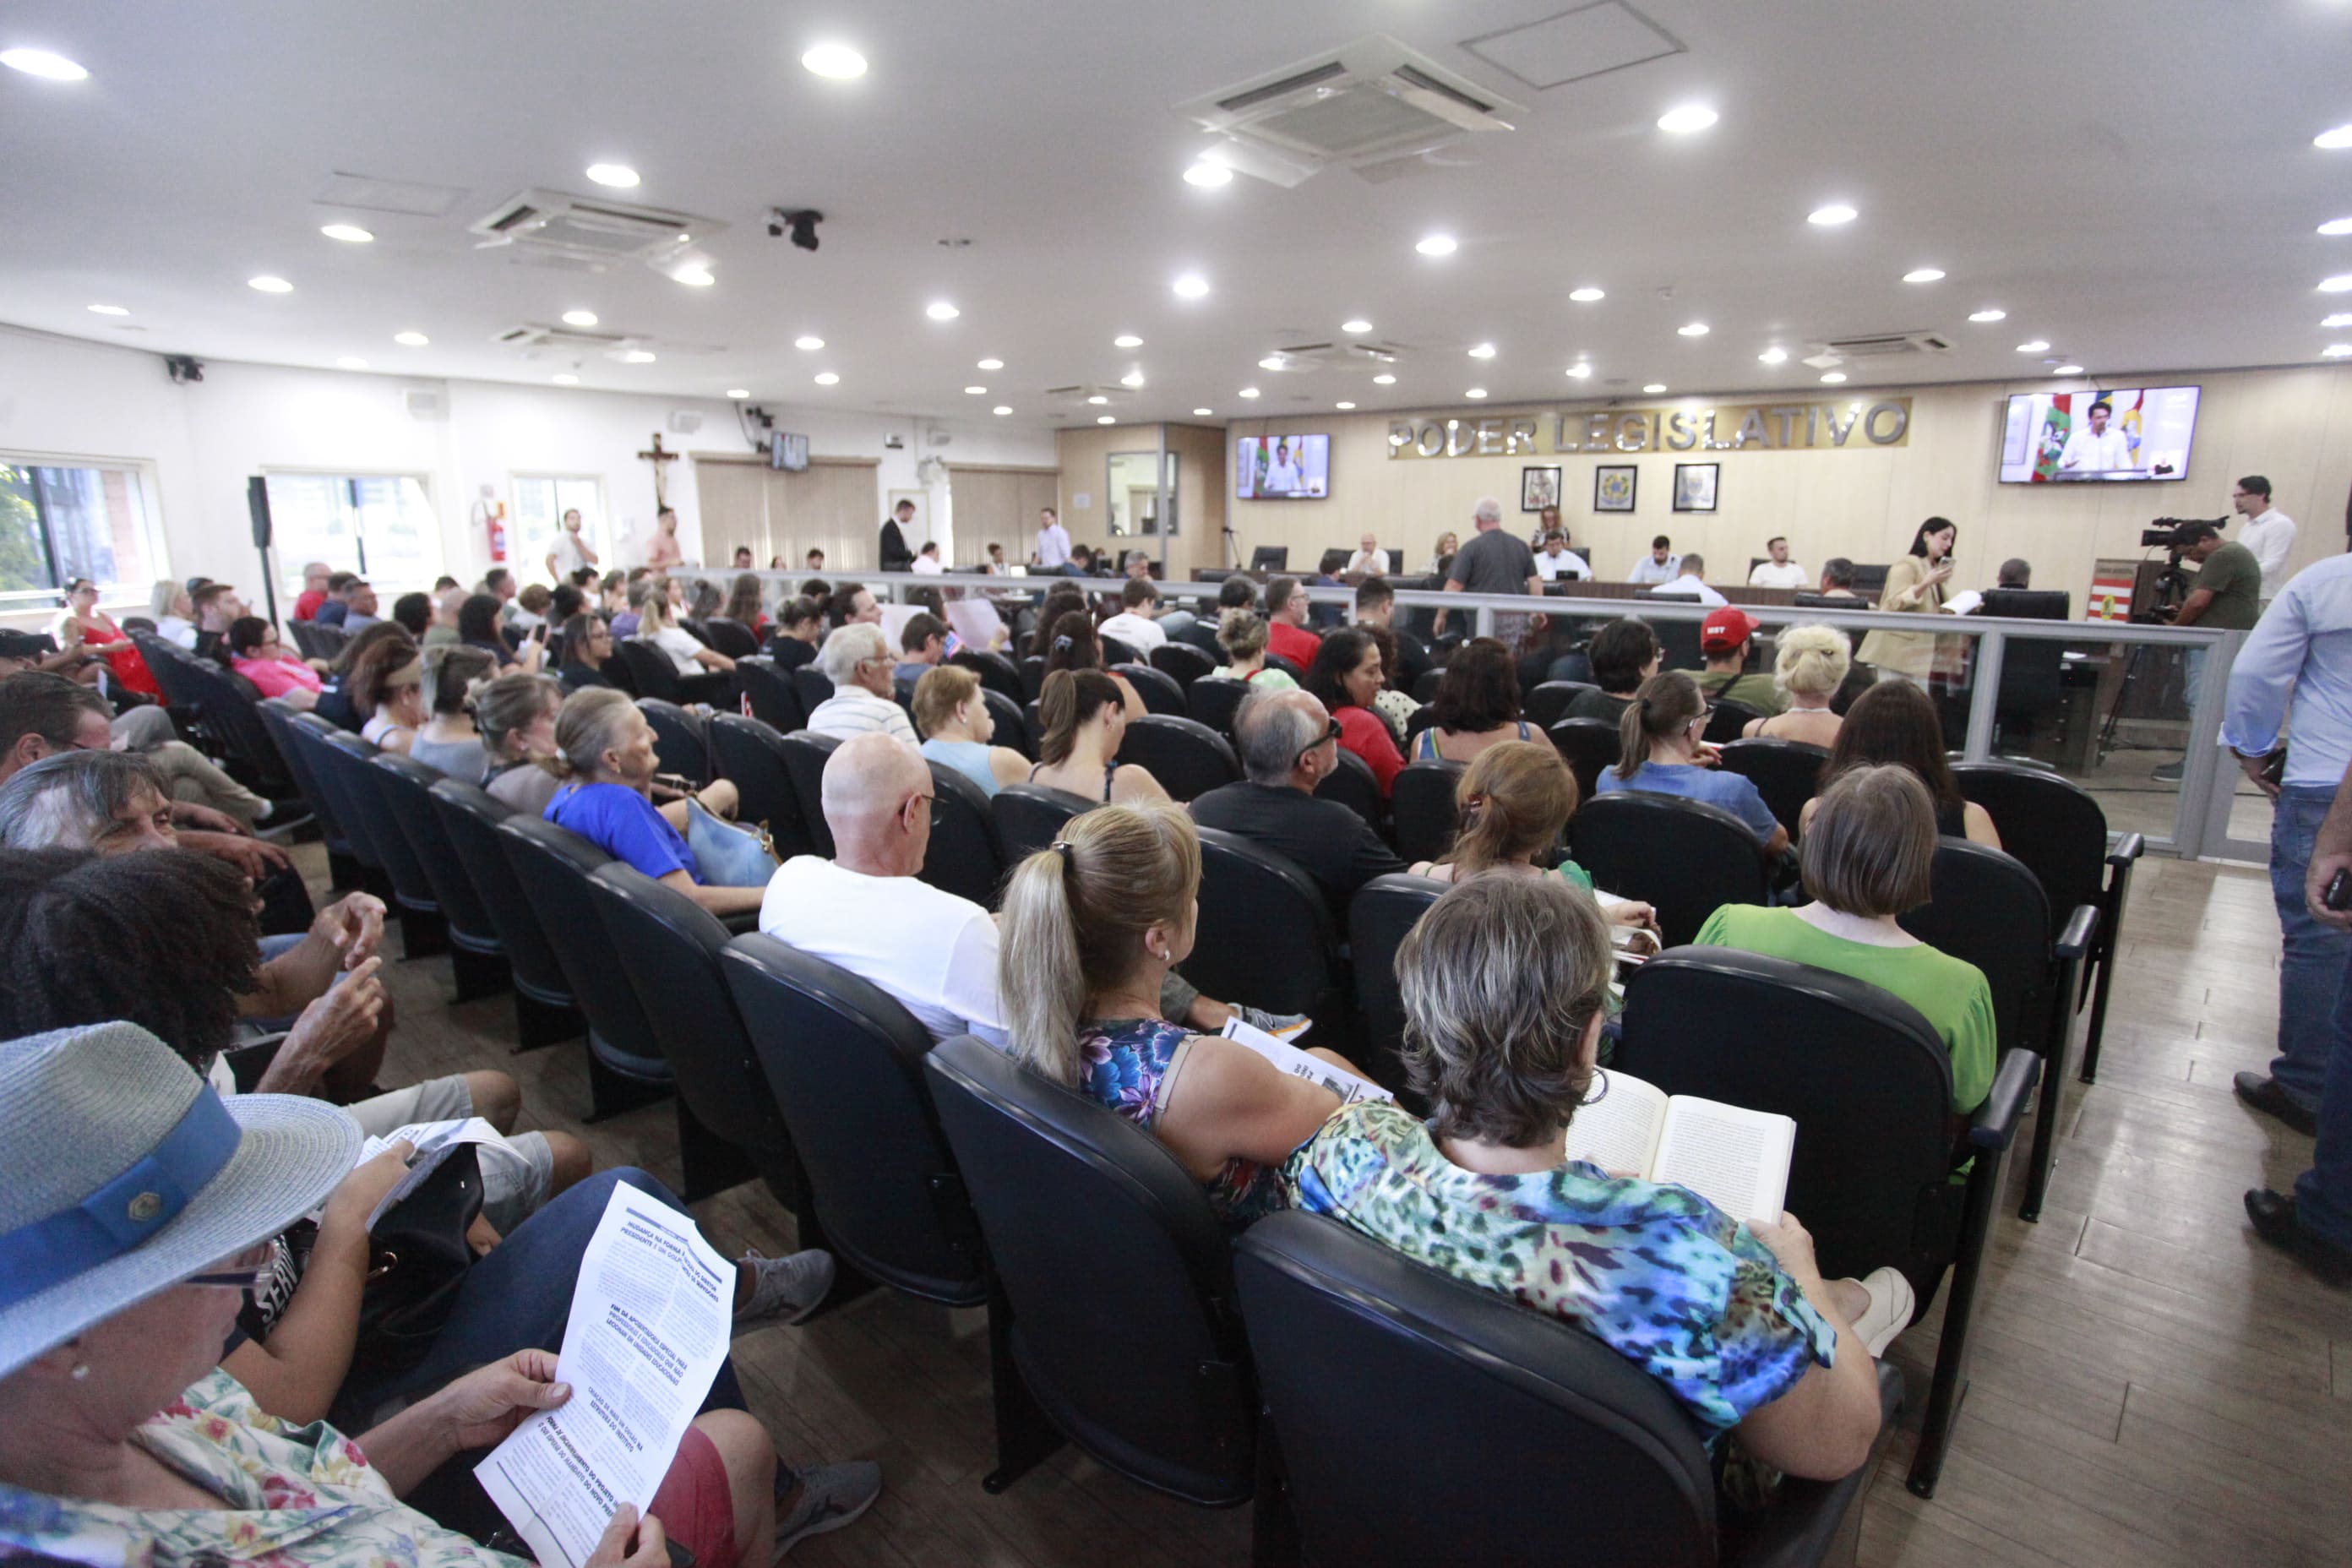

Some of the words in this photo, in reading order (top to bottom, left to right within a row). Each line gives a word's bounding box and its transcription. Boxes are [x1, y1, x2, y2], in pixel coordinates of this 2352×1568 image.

[1388, 418, 1537, 459] PODER
[1554, 401, 1907, 453] LEGISLATIVO
[611, 1304, 621, 1313] FIM
[590, 1400, 611, 1424] ESTRUTURA
[615, 1429, 634, 1452] INSTITUTO
[584, 1479, 592, 1490] DO
[590, 1488, 603, 1505] NOVO
[589, 1470, 596, 1480] DO
[595, 1478, 614, 1502] PROJETO
